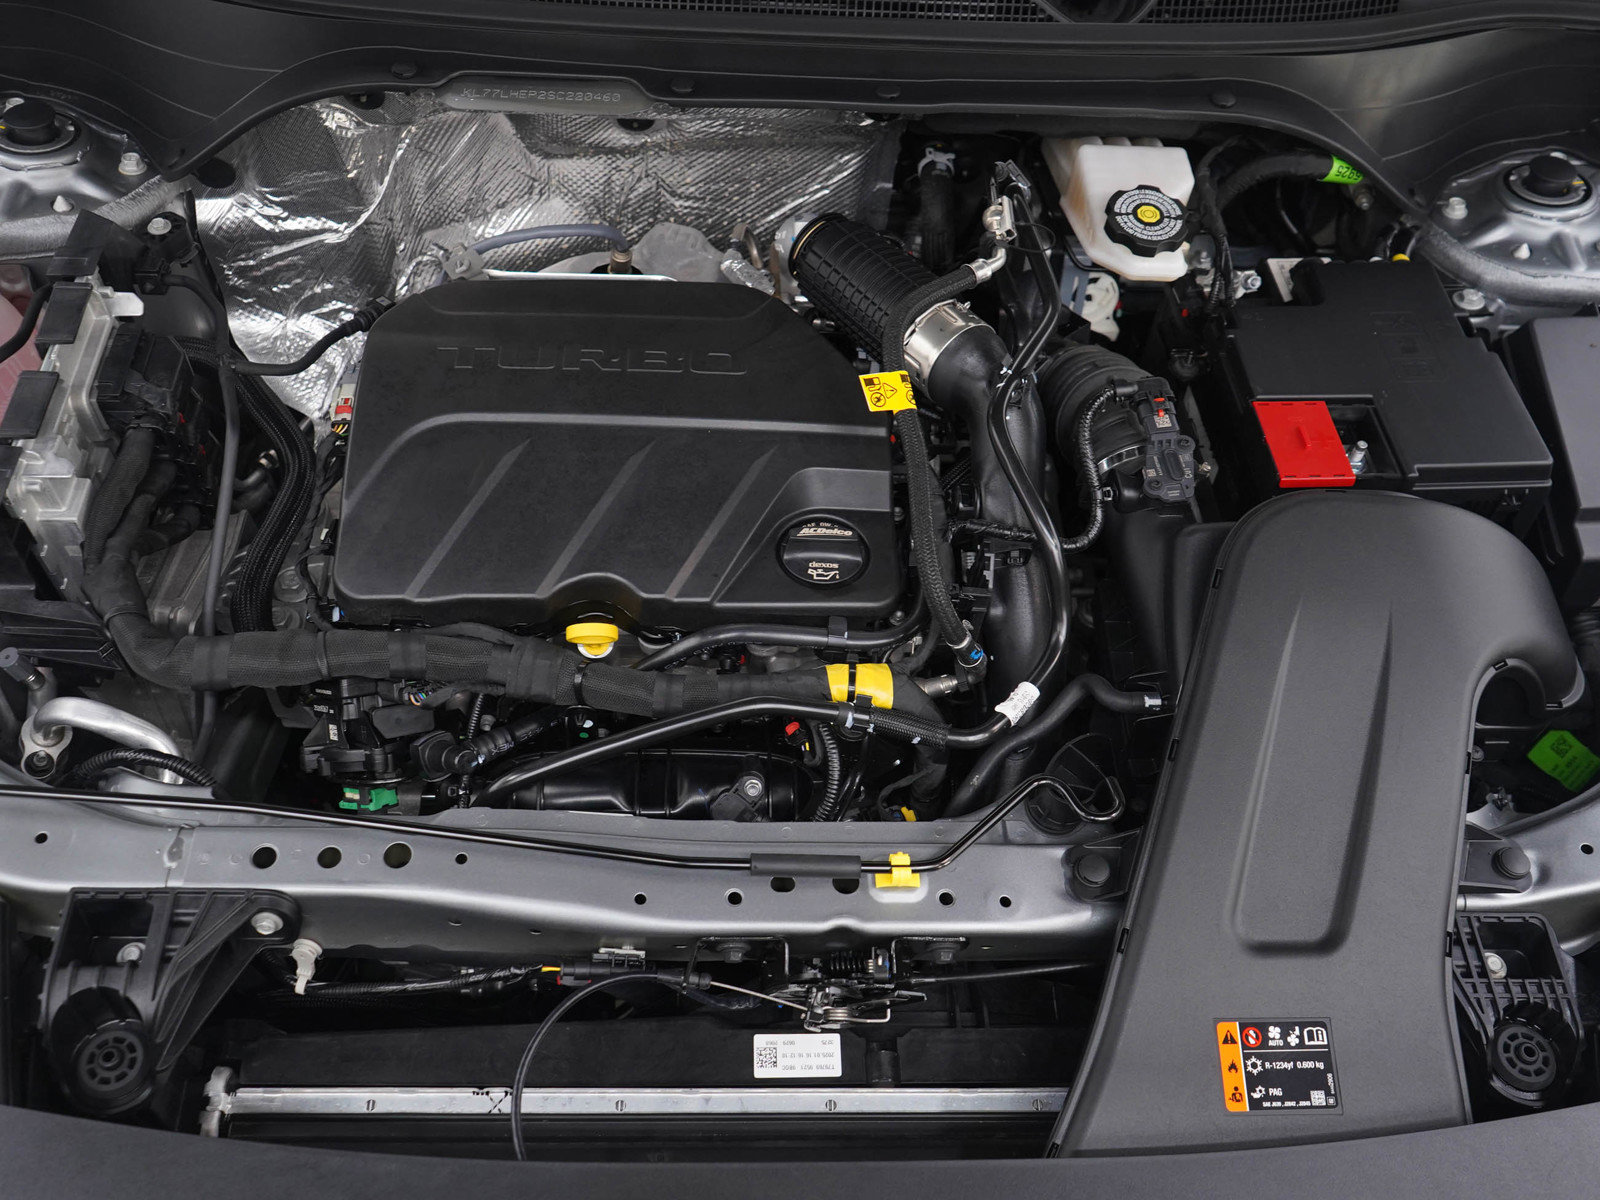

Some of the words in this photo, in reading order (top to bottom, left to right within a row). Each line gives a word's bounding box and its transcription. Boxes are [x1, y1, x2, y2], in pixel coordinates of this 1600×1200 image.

[436, 345, 747, 376] TURBO
[798, 528, 853, 536] ACDelco
[1265, 1062, 1293, 1070] R-1234yf
[1315, 1061, 1325, 1070] kg
